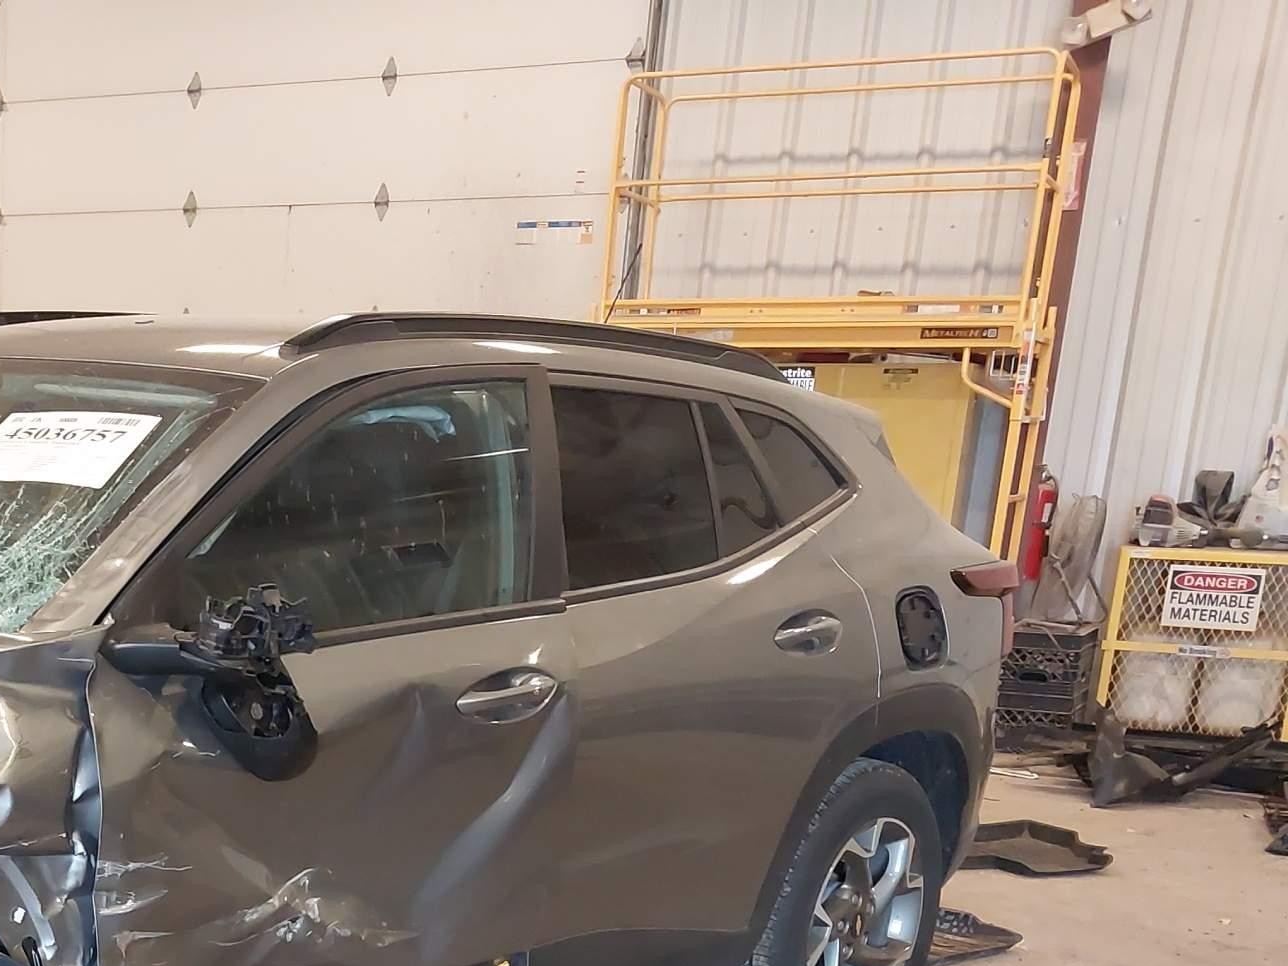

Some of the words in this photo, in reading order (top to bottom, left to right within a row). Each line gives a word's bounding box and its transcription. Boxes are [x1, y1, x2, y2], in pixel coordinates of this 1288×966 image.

[782, 367, 812, 378] strite
[5, 427, 128, 444] 45036757
[1183, 575, 1248, 590] DANGER
[1169, 591, 1256, 609] FLAMMABLE
[1169, 607, 1250, 625] MATERIALS
